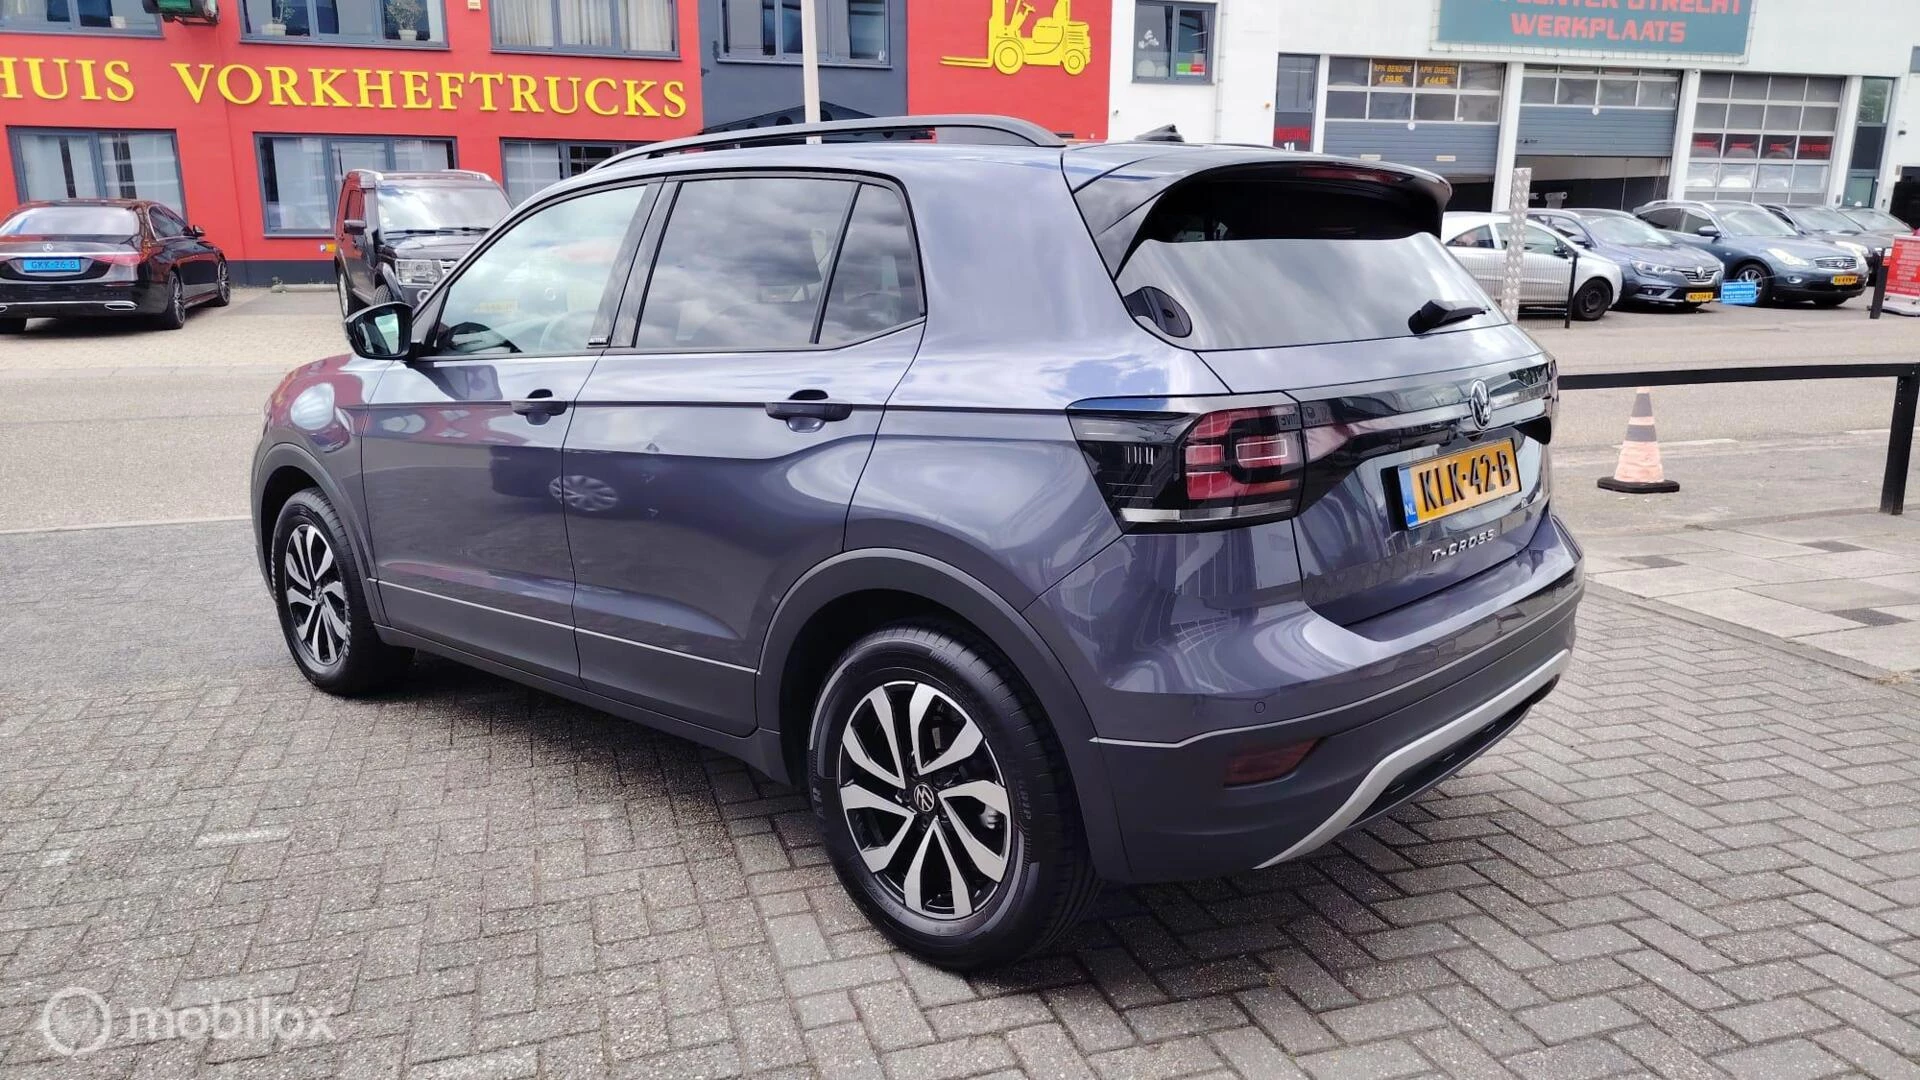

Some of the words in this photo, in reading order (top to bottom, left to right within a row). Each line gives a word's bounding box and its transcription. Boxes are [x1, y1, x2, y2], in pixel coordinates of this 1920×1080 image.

[1511, 12, 1687, 43] WERKPLAATS
[170, 62, 687, 118] VORKHEFTRUCKS
[1418, 450, 1512, 512] KLK-42-B
[1405, 503, 1416, 516] NL
[1431, 528, 1495, 562] T-CROSS
